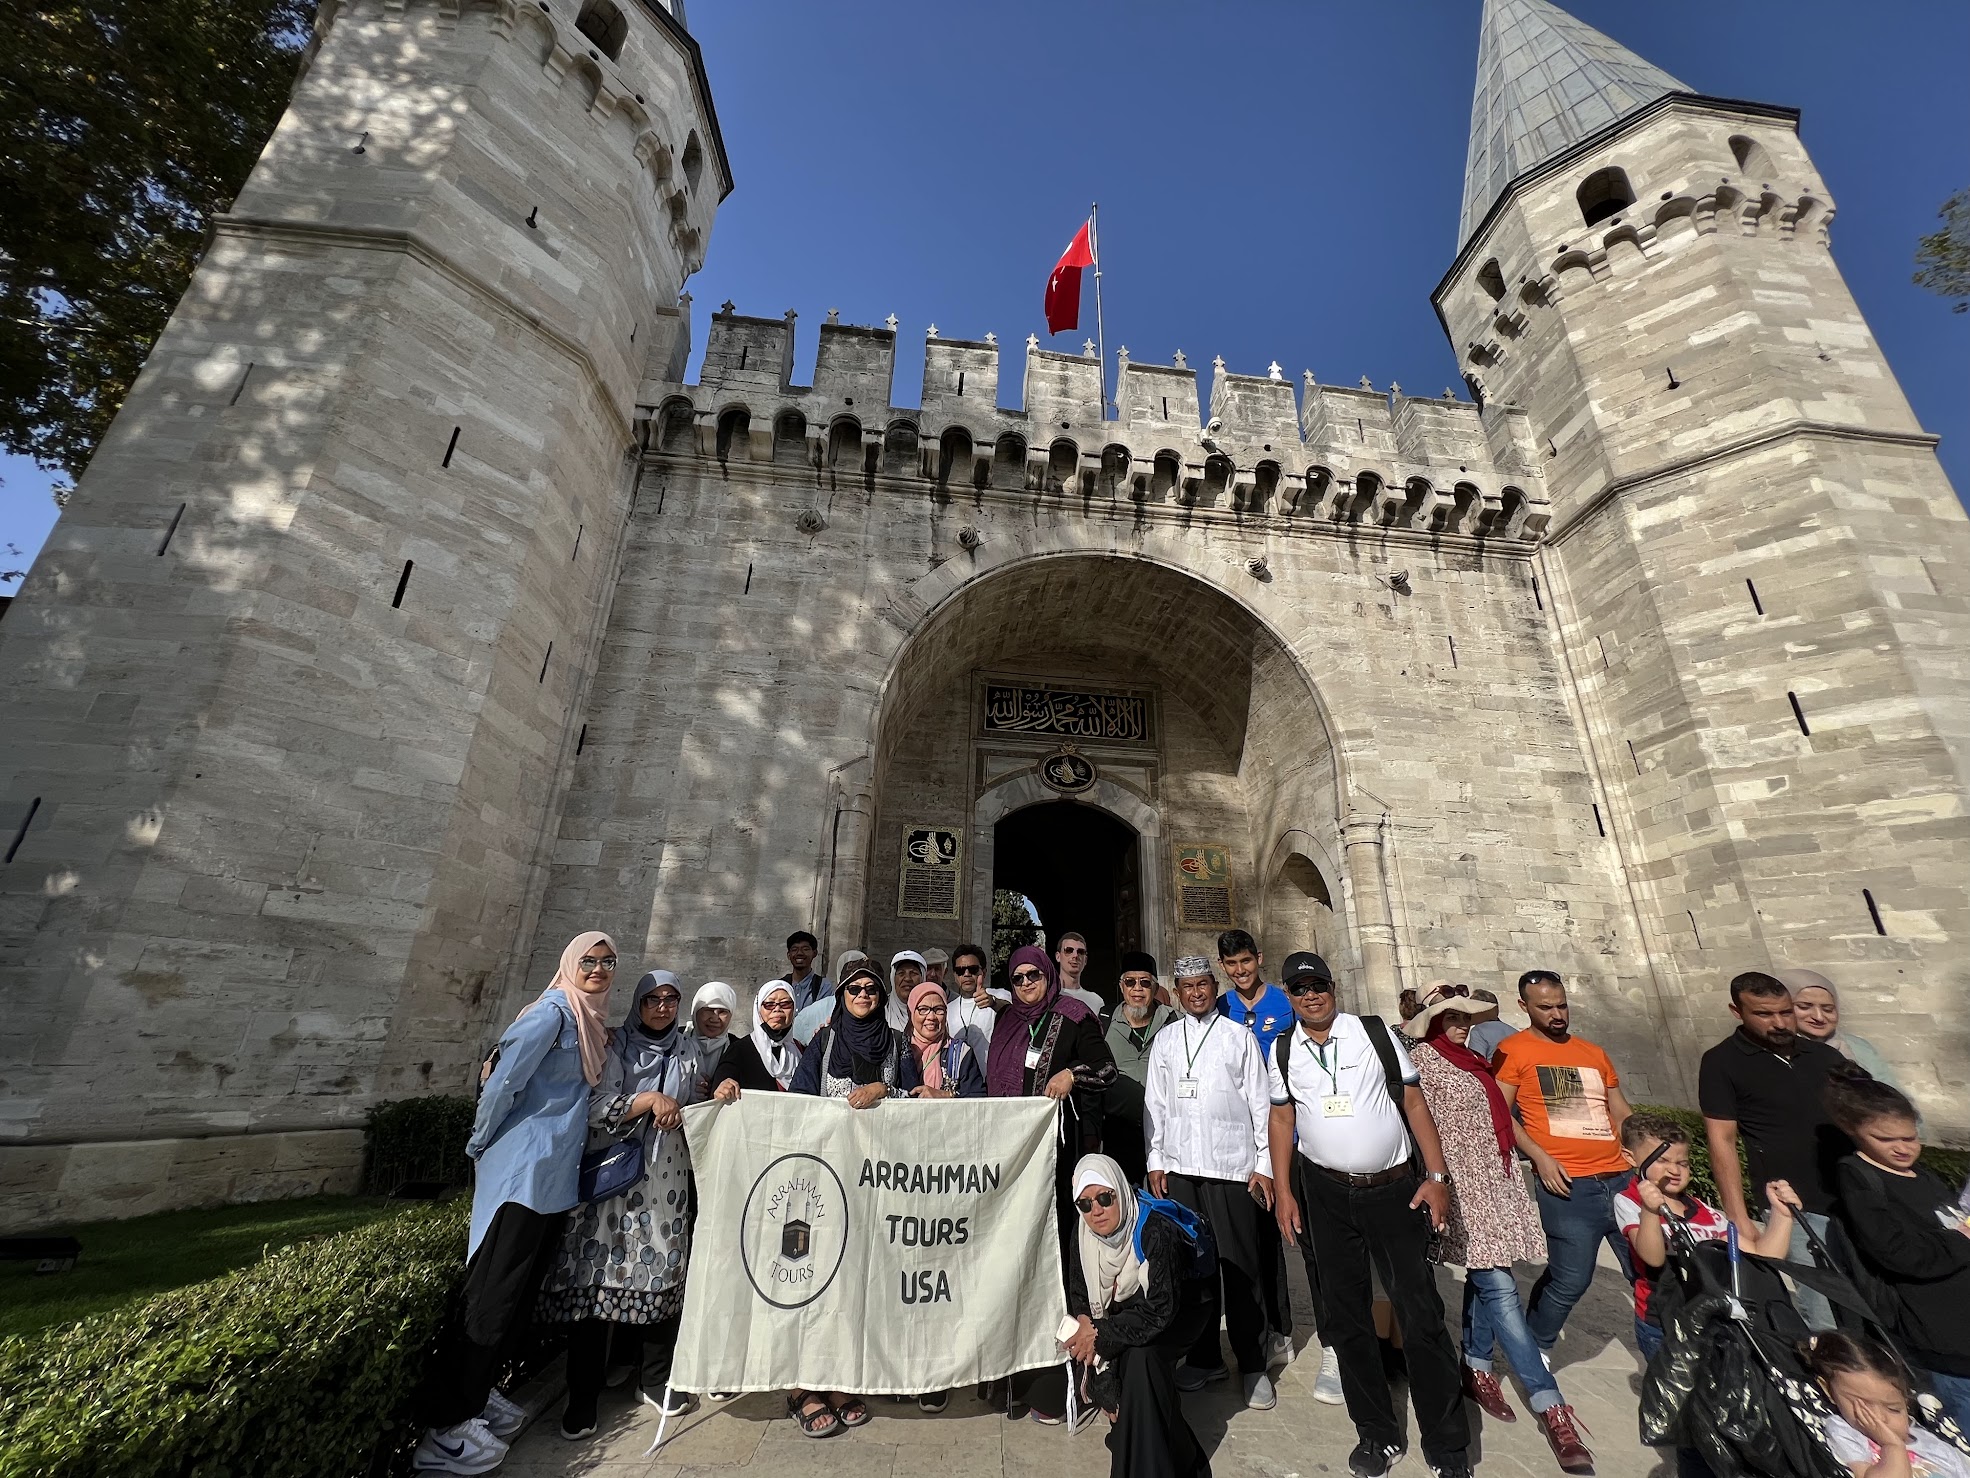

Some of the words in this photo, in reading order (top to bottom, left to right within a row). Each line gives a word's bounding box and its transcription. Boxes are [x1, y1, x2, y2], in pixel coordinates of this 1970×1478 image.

[859, 1159, 1001, 1194] ARRAHMAN
[767, 1178, 825, 1218] ARRAHMAN
[886, 1214, 969, 1247] TOURS
[771, 1260, 814, 1283] TOURS
[902, 1270, 952, 1304] USA
